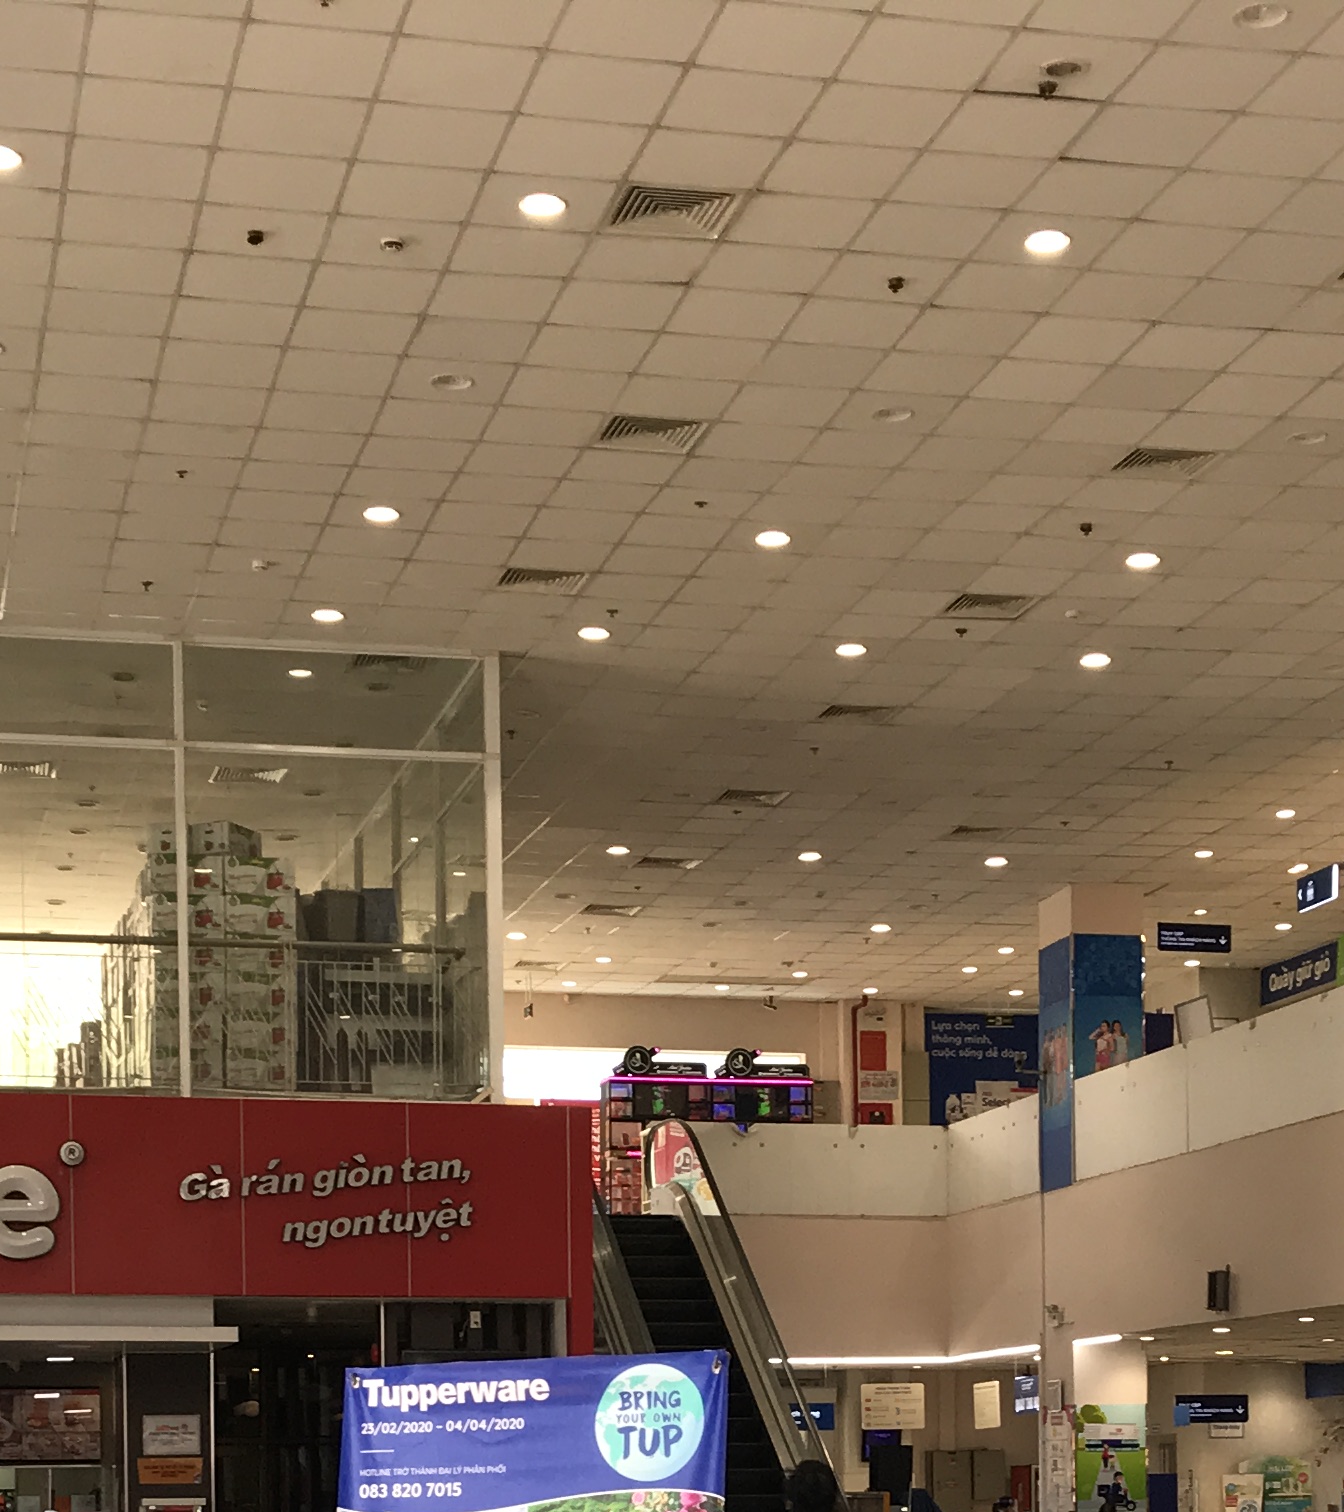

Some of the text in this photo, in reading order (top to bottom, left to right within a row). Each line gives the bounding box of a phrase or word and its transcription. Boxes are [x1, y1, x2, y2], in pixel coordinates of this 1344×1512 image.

[179, 1154, 471, 1201] Gà rán giòn tan,
[362, 1378, 550, 1412] Tupperware
[618, 1390, 681, 1411] BRING
[445, 1417, 525, 1433] 04/04/2020
[616, 1412, 681, 1424] YOUR OWN
[617, 1424, 683, 1460] TUP
[359, 1482, 462, 1499] 083 820 7015
